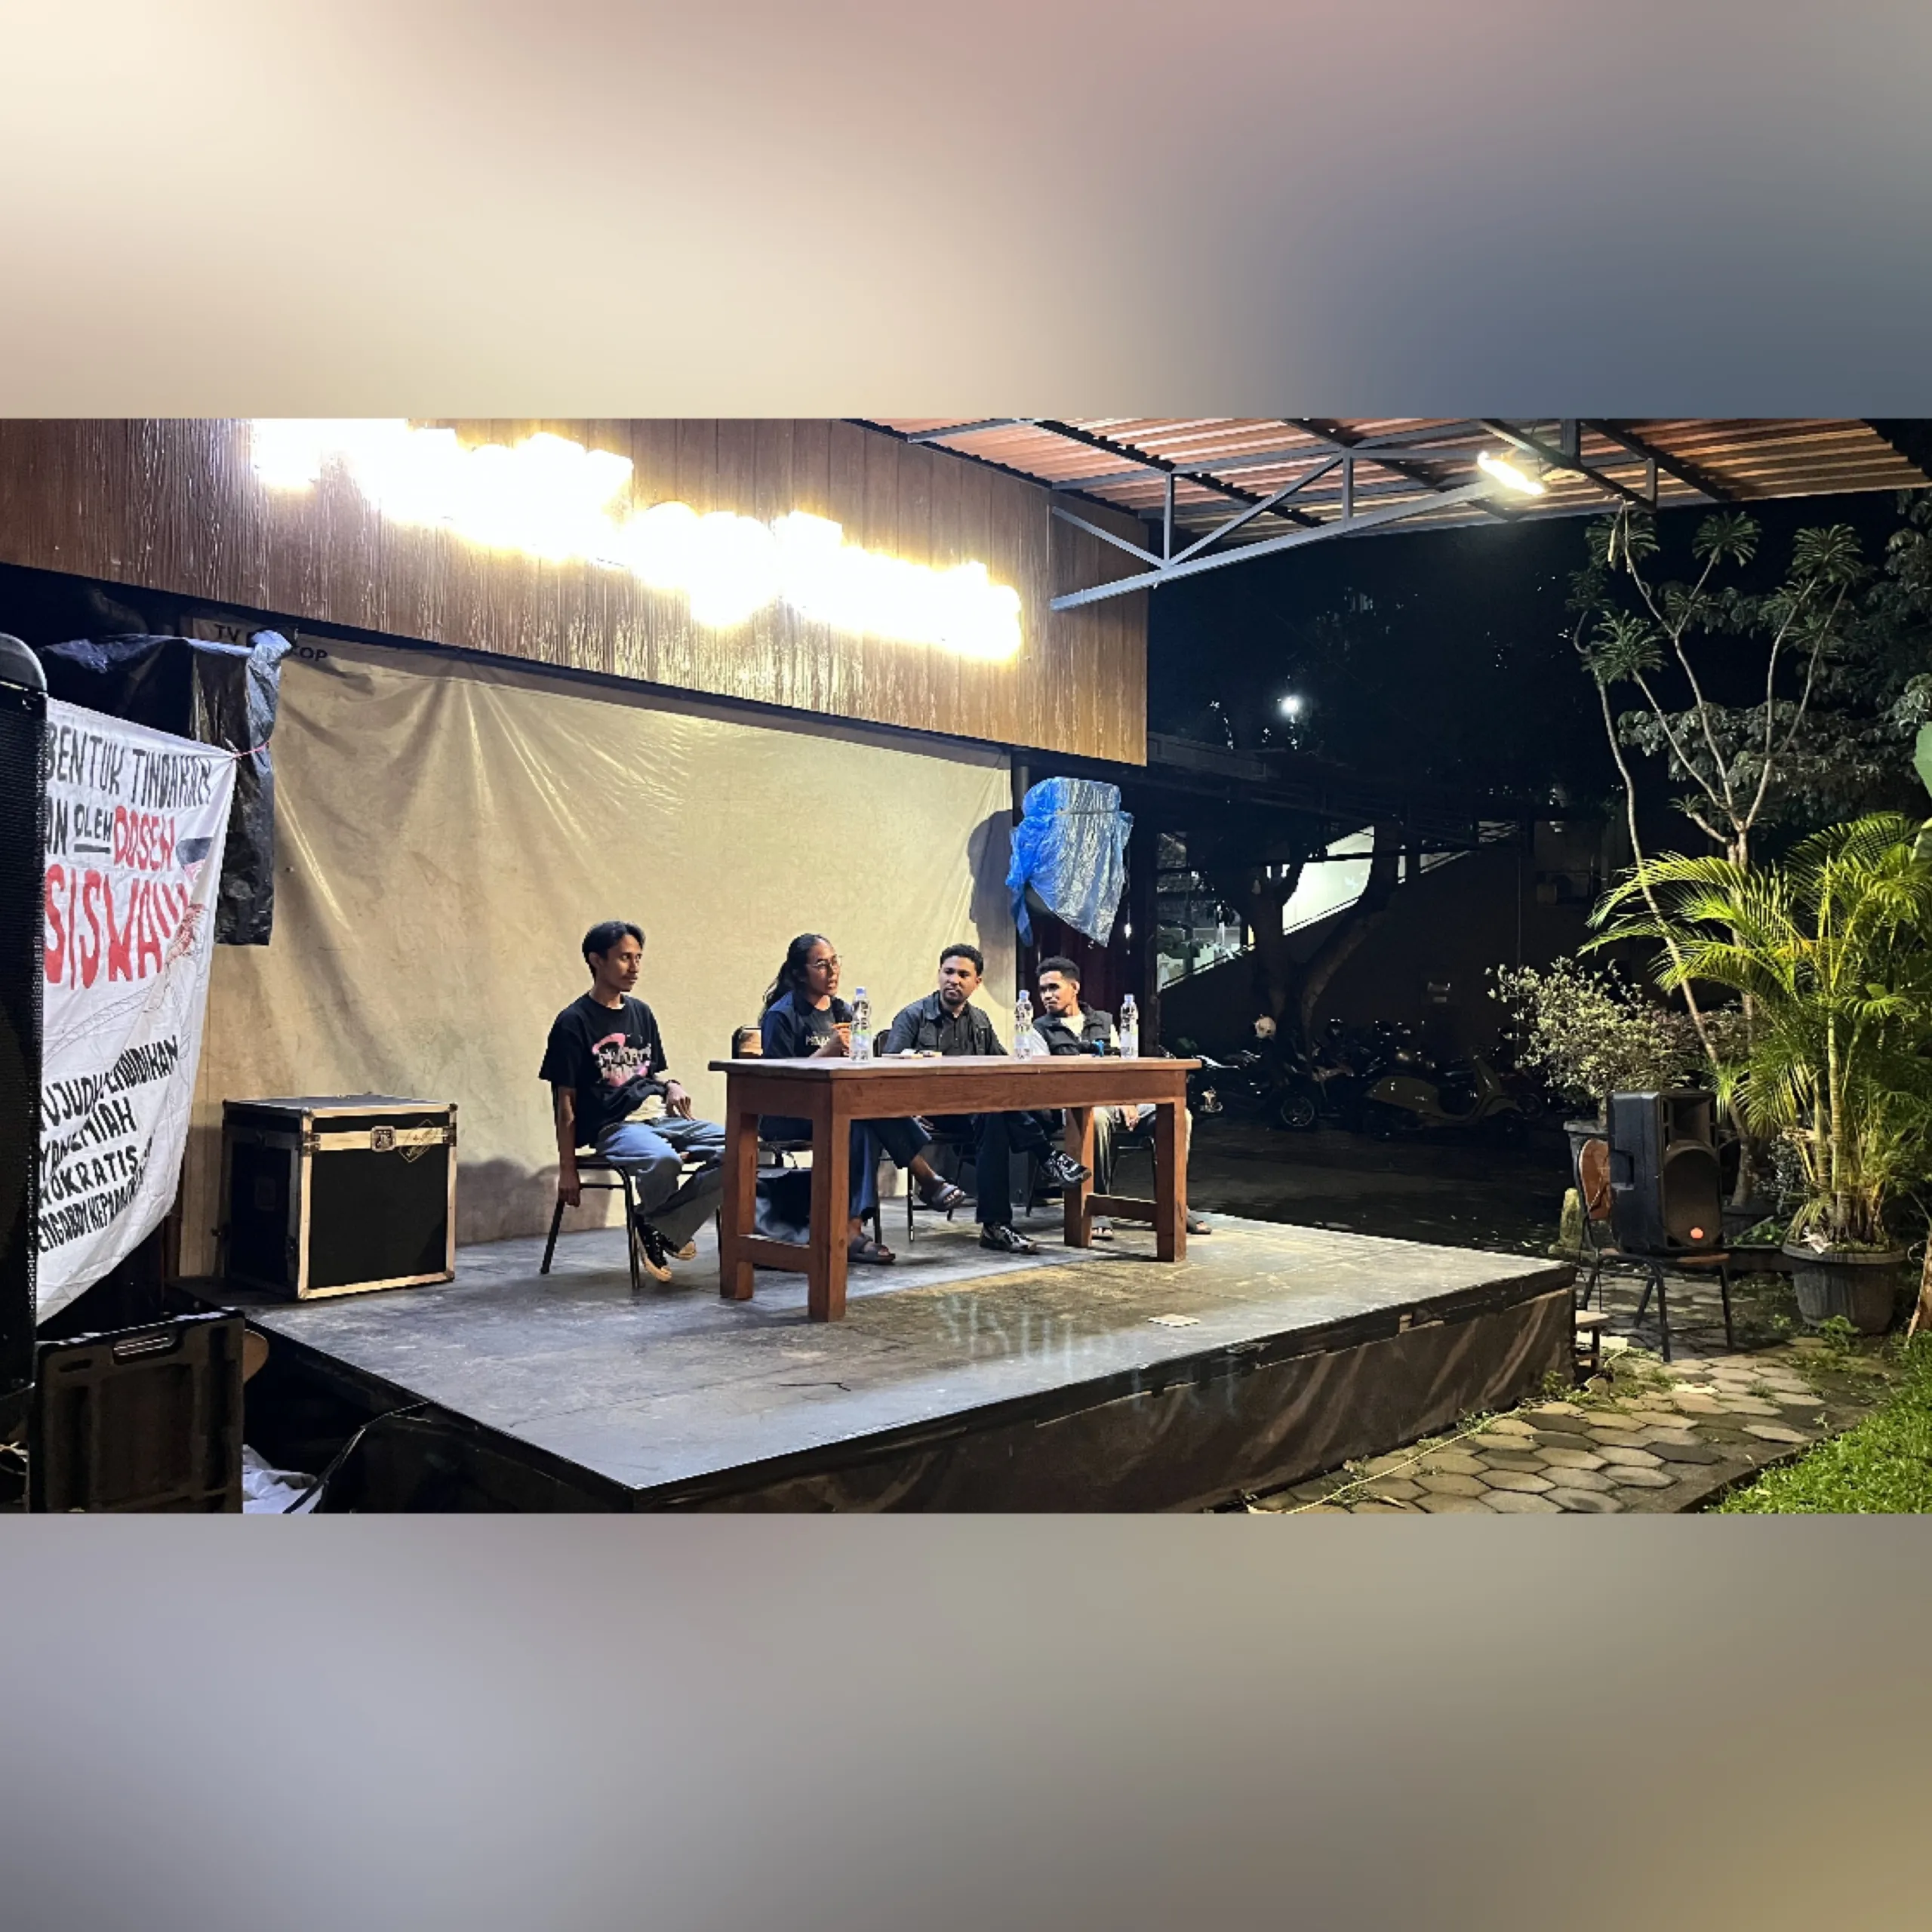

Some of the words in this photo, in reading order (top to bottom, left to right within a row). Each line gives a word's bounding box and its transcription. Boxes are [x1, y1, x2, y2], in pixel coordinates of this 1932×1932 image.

[214, 623, 240, 641] TV
[45, 721, 125, 795] BENTUK
[74, 803, 113, 842] OLEH
[113, 804, 175, 872] DOSEN
